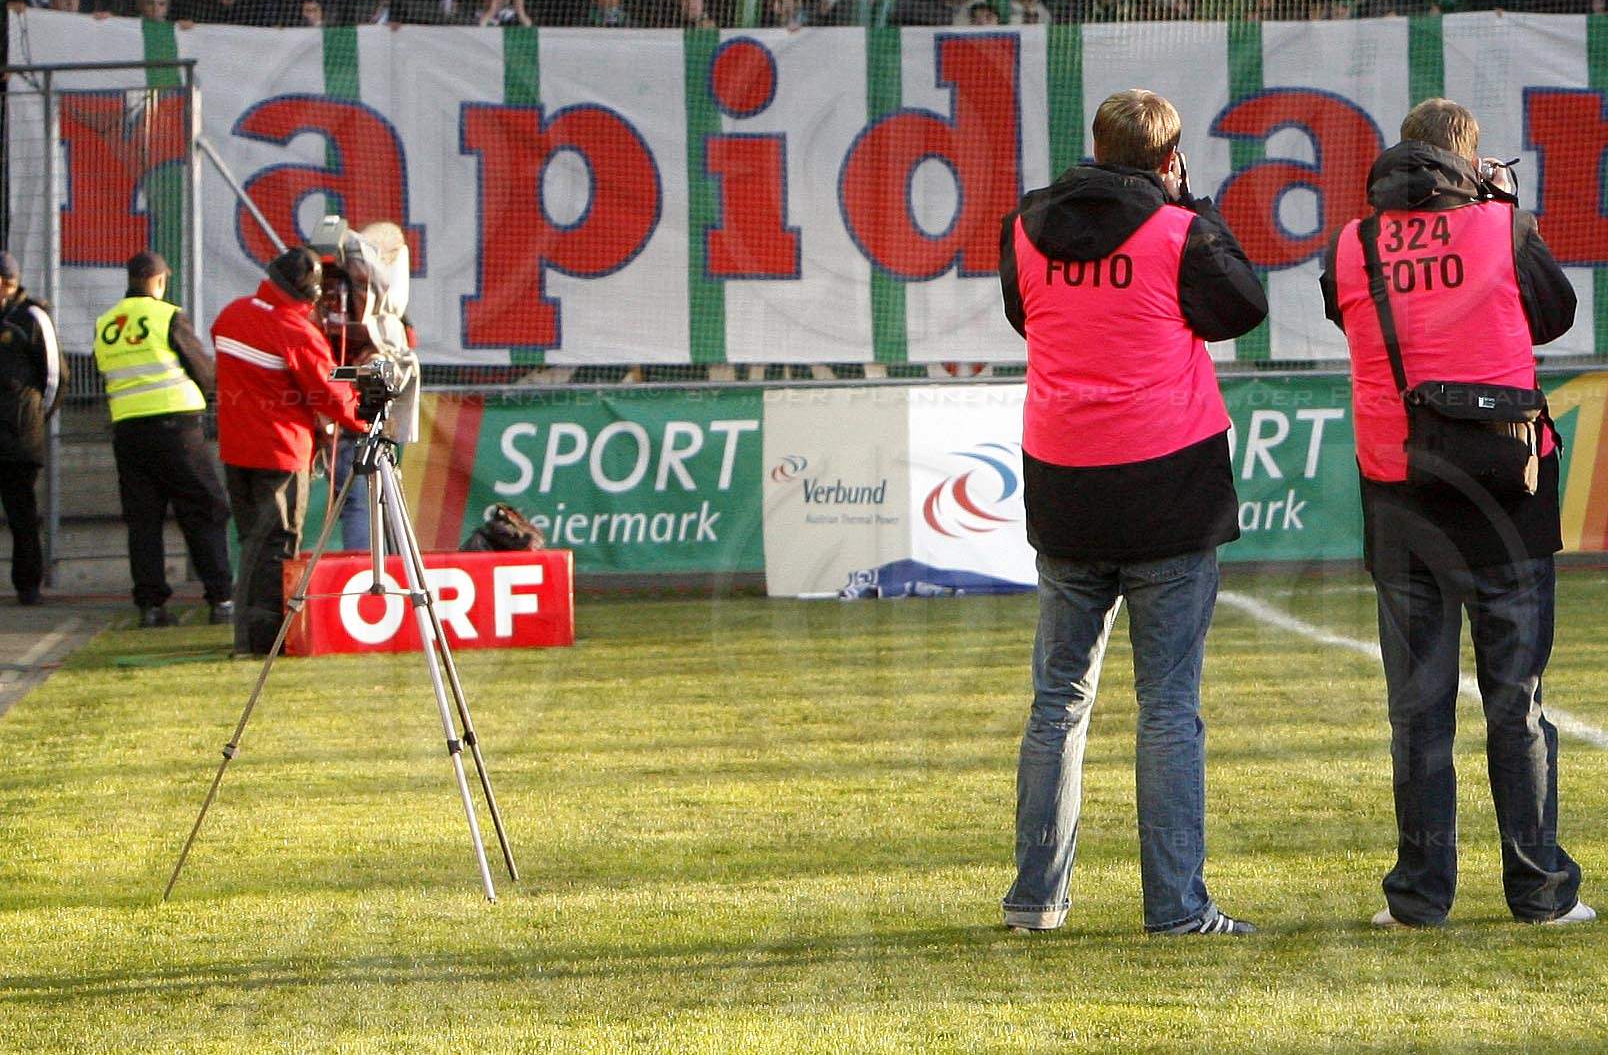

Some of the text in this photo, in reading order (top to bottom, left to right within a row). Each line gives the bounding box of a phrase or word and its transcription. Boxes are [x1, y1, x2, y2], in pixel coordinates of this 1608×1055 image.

[60, 32, 1023, 350] rapid
[1210, 87, 1384, 270] a
[1384, 215, 1451, 252] 324
[1045, 253, 1133, 289] FOTO
[1381, 254, 1464, 293] FOTO
[493, 420, 760, 496] SPORT
[803, 478, 887, 504] Verbund
[484, 501, 721, 545] eiermark
[339, 565, 543, 644] ORF
